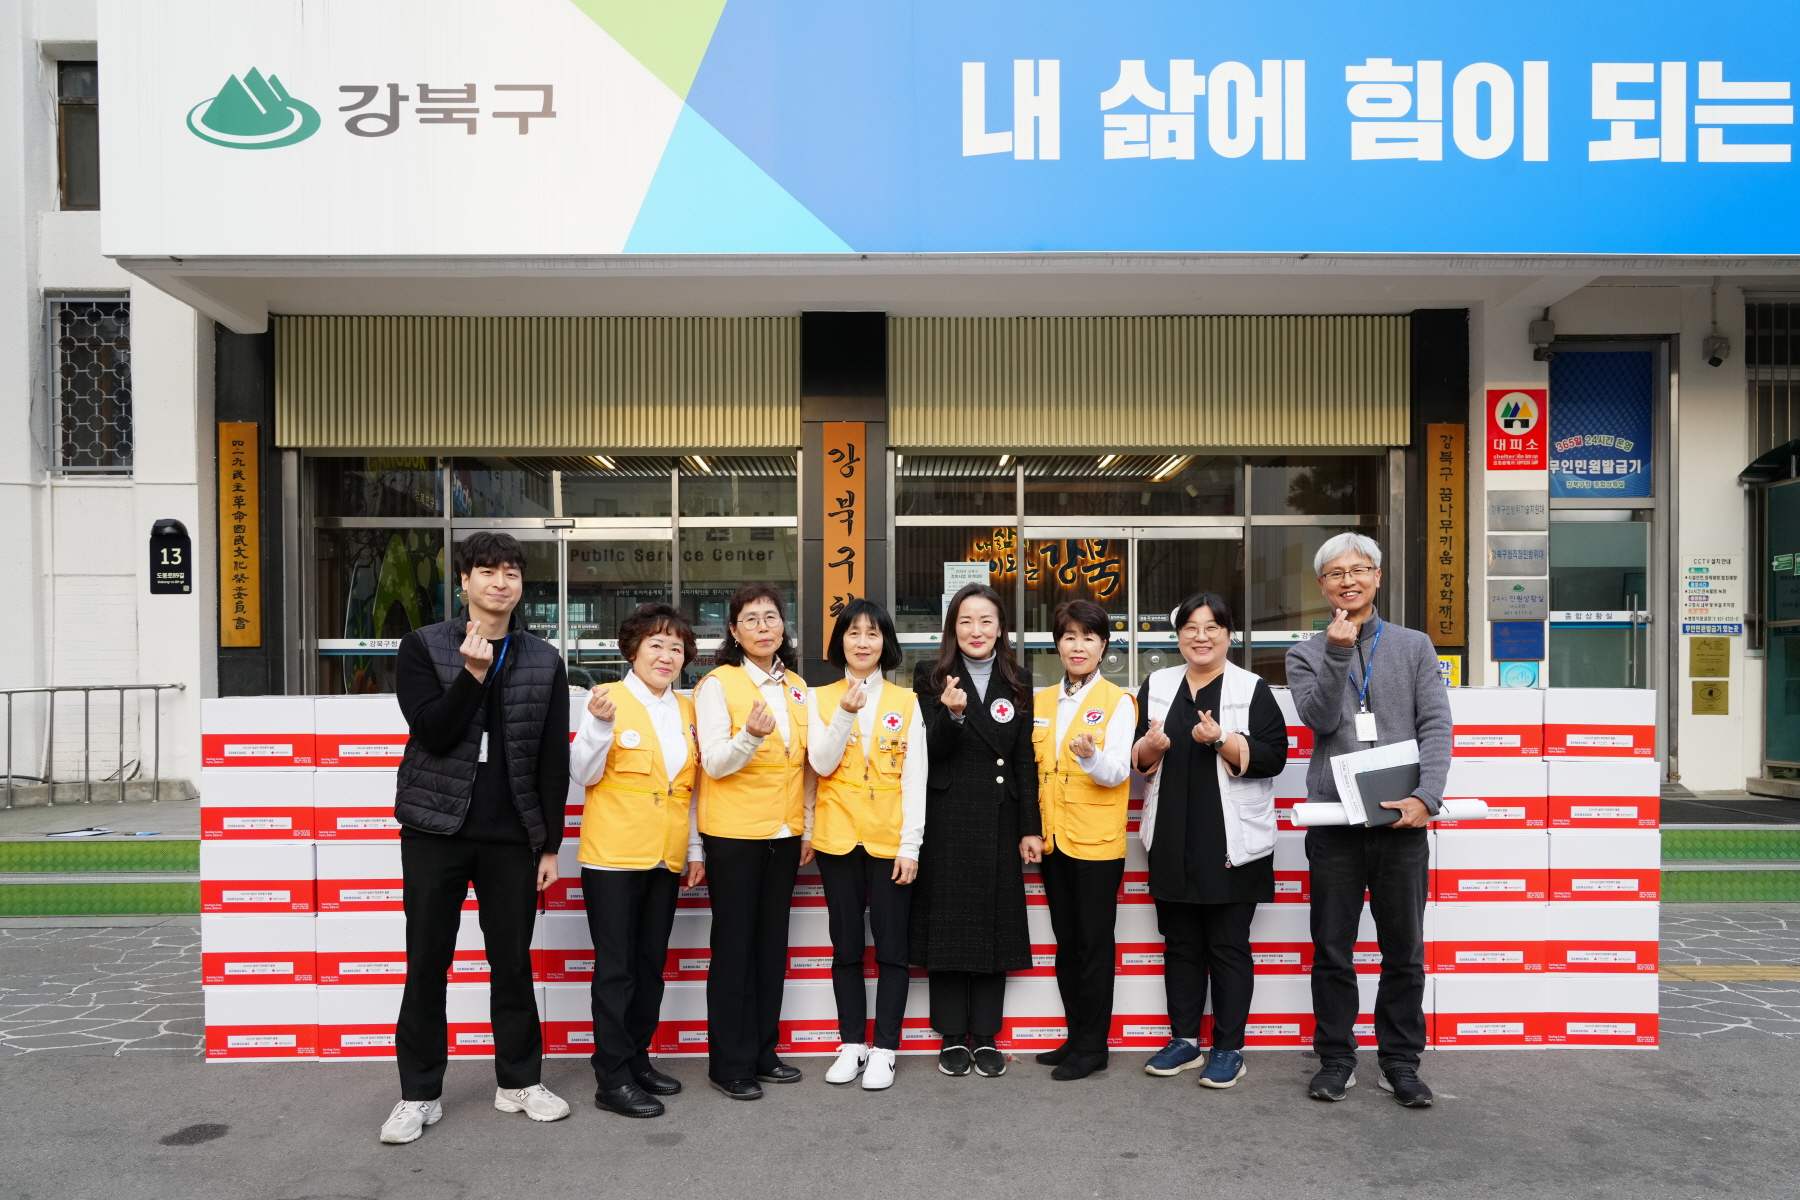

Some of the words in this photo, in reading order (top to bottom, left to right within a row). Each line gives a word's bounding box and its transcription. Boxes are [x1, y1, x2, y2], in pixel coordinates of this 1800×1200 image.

[337, 83, 557, 138] 강북구
[962, 59, 1061, 161] 내
[1100, 59, 1306, 161] 삶에
[1346, 57, 1549, 162] 힘이
[1588, 60, 1795, 163] 되는
[1493, 438, 1539, 451] 대피소
[1555, 434, 1584, 452] 365일
[1585, 434, 1615, 447] 24시간
[1615, 437, 1634, 453] 운영
[1439, 434, 1454, 482] 강북구
[1550, 459, 1641, 474] 무인민원발급기
[1439, 487, 1454, 565] 꿈나무키움
[160, 547, 182, 565] 13
[570, 548, 625, 562] Public
[712, 548, 775, 562] Center
[1439, 573, 1455, 635] 장학재단
[1564, 612, 1612, 620] 종합상황실
